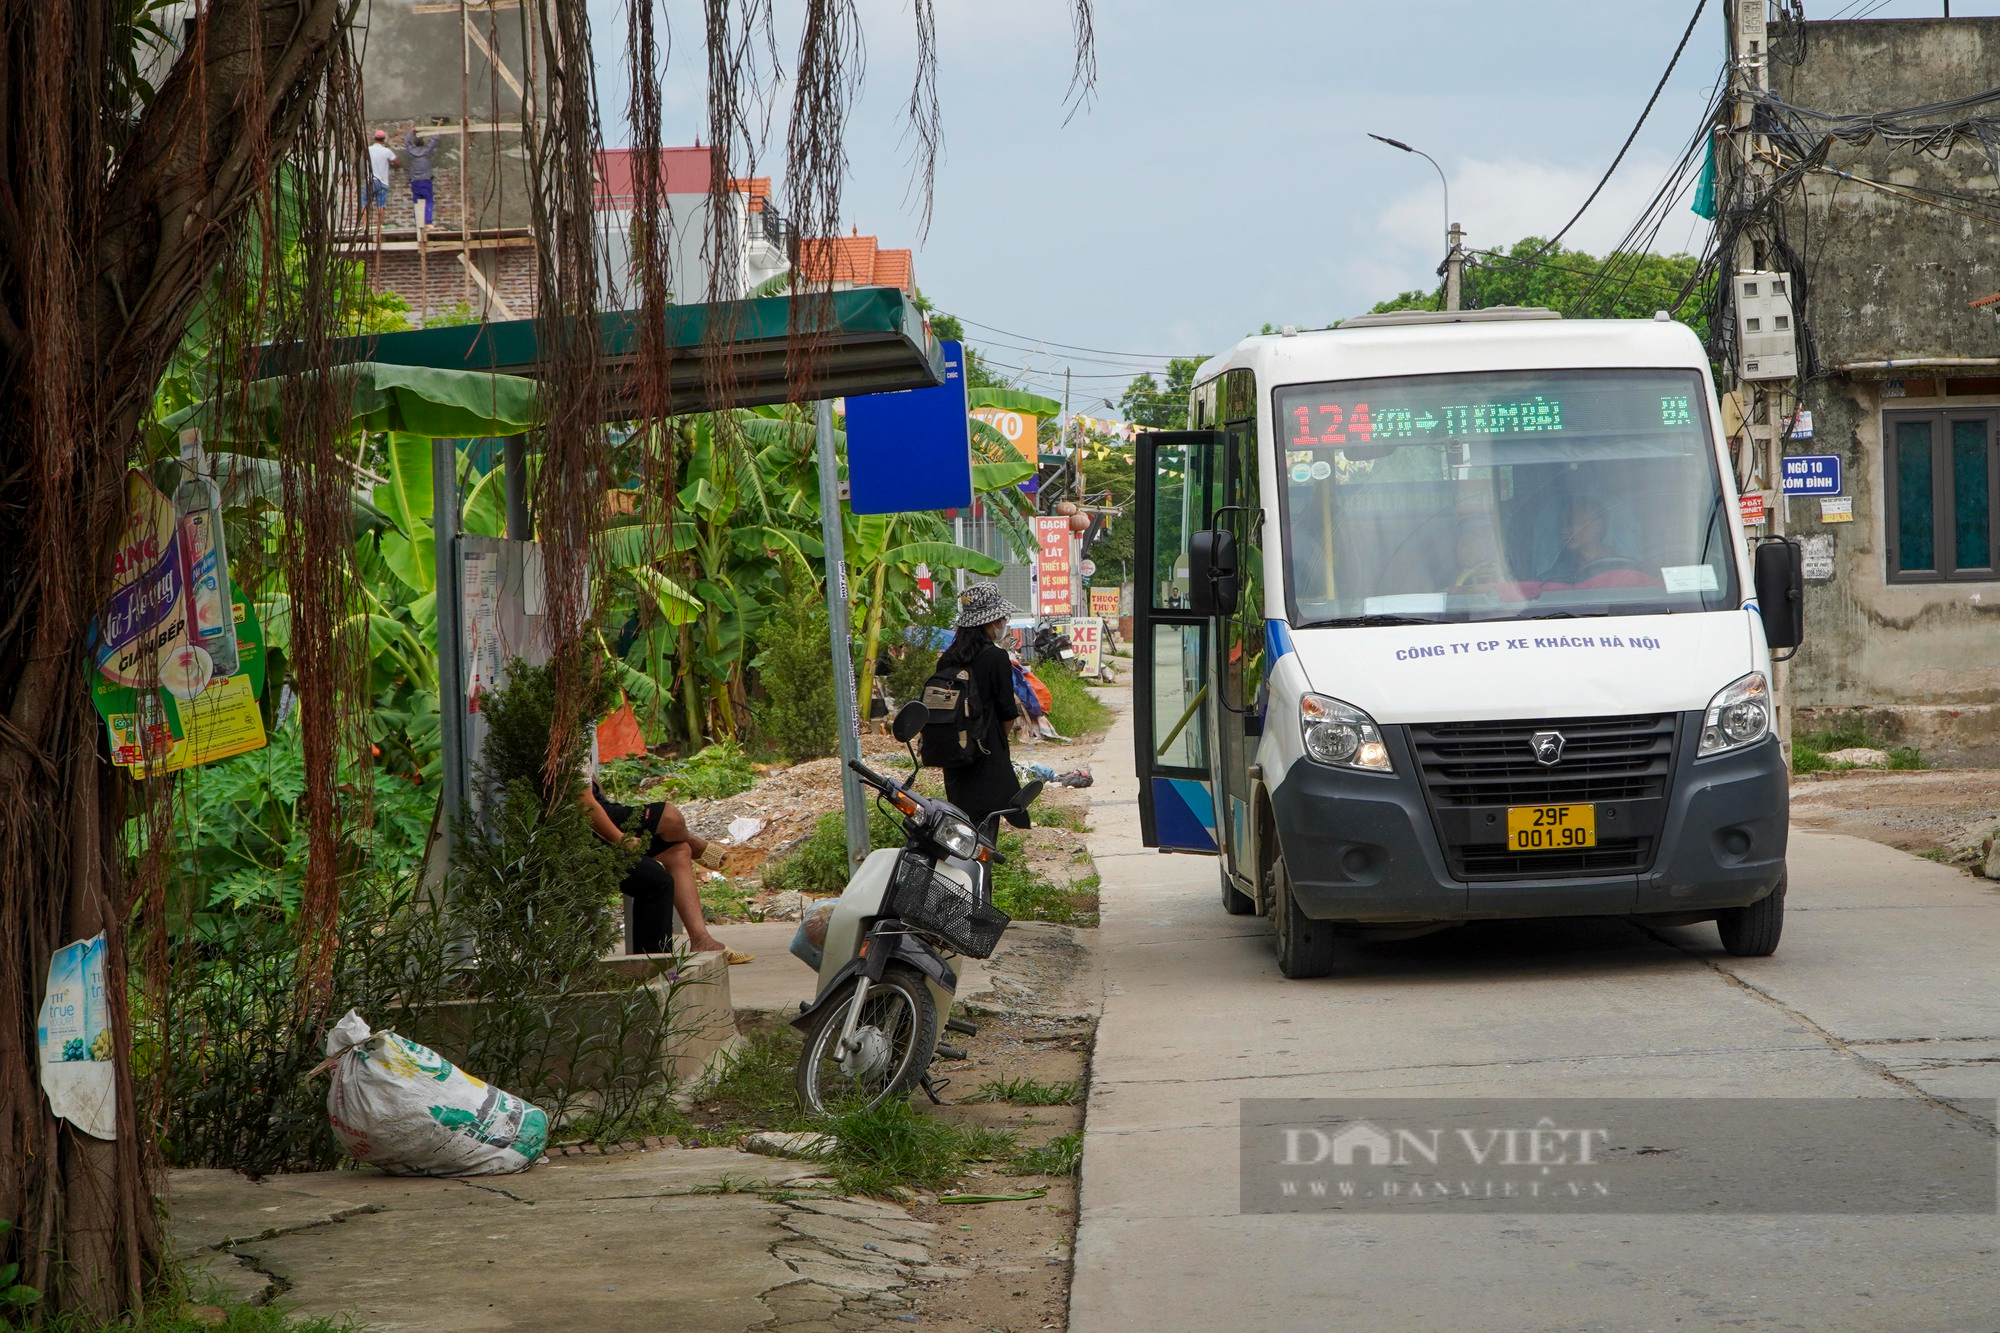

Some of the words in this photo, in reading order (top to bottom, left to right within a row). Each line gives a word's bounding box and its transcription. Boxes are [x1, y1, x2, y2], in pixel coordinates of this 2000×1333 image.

[1294, 404, 1373, 444] 124
[1788, 460, 1808, 474] NGÕ
[1811, 462, 1822, 473] 10
[1806, 476, 1832, 488] ĐÌNH
[1040, 520, 1066, 530] GẠCH
[1047, 532, 1060, 543] ỐP
[1046, 546, 1063, 557] LÁT
[1052, 576, 1068, 585] SINH
[1041, 602, 1054, 613] ỐG
[1073, 627, 1097, 642] XE
[1396, 646, 1445, 661] CÔNG
[1450, 643, 1470, 654] TY
[1476, 640, 1500, 652] CP
[1507, 638, 1530, 650] XE
[1534, 636, 1595, 648] KHÁCH
[1600, 635, 1625, 648] HÀ
[1629, 636, 1661, 650] NỘI
[1532, 808, 1570, 826] 29F
[1518, 828, 1586, 848] 001.90
[50, 1004, 74, 1018] true
